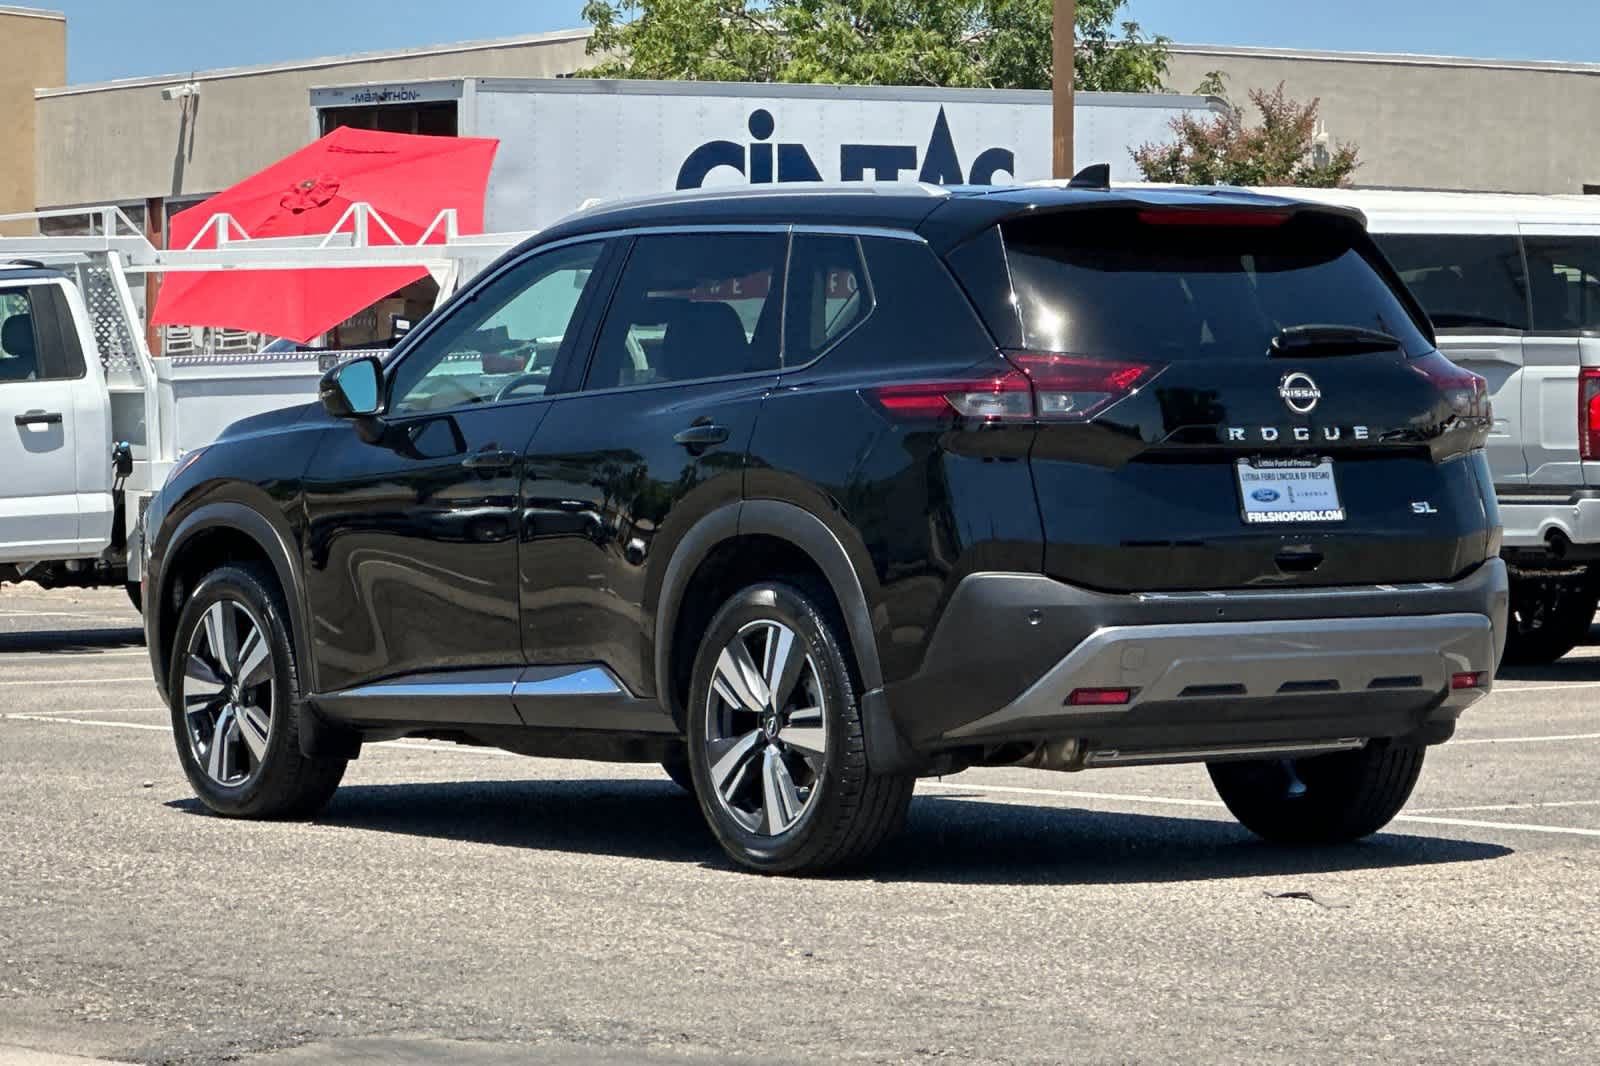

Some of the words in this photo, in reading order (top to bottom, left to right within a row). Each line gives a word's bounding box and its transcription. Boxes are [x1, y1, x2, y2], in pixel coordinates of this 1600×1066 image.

[1281, 389, 1321, 398] NISSAN
[1228, 426, 1369, 441] ROGUE
[1411, 501, 1438, 513] SL
